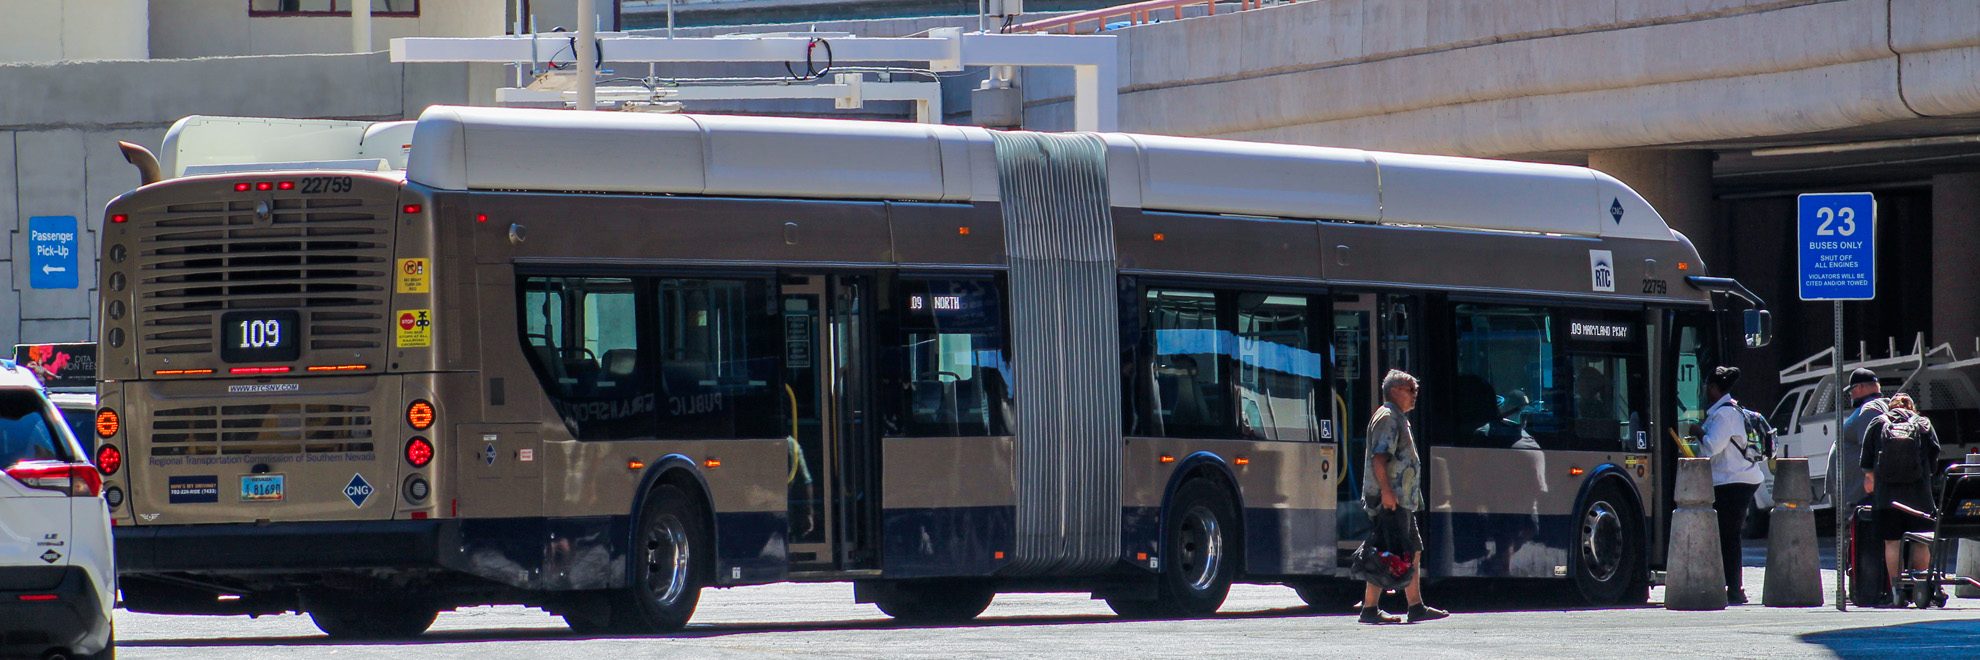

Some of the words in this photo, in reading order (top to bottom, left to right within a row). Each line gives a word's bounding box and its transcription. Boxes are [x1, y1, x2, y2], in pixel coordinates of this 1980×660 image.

[301, 176, 352, 194] 22759
[1611, 206, 1622, 215] CNG
[1816, 206, 1856, 236] 23
[31, 230, 74, 244] Passenger
[37, 245, 69, 259] Pick-Up
[1809, 241, 1838, 250] BUSES
[1840, 241, 1863, 249] ONLY
[1595, 268, 1611, 288] RTC
[1642, 280, 1667, 294] 22759
[910, 296, 922, 310] 09
[934, 296, 960, 310] NORTH
[240, 319, 281, 348] 109
[1570, 322, 1582, 335] 09
[1582, 324, 1610, 337] MARYLAND
[1612, 326, 1627, 338] PKWY
[75, 355, 91, 363] DITA
[63, 362, 80, 371] VON
[230, 384, 297, 392] WWW.RTCSNV.COM
[149, 456, 182, 467] Regional
[185, 454, 242, 465] Transportation
[243, 453, 294, 464] Commission
[295, 453, 304, 462] of
[305, 452, 343, 462] Southern
[344, 451, 376, 461] Nevada
[347, 485, 369, 496] CNG
